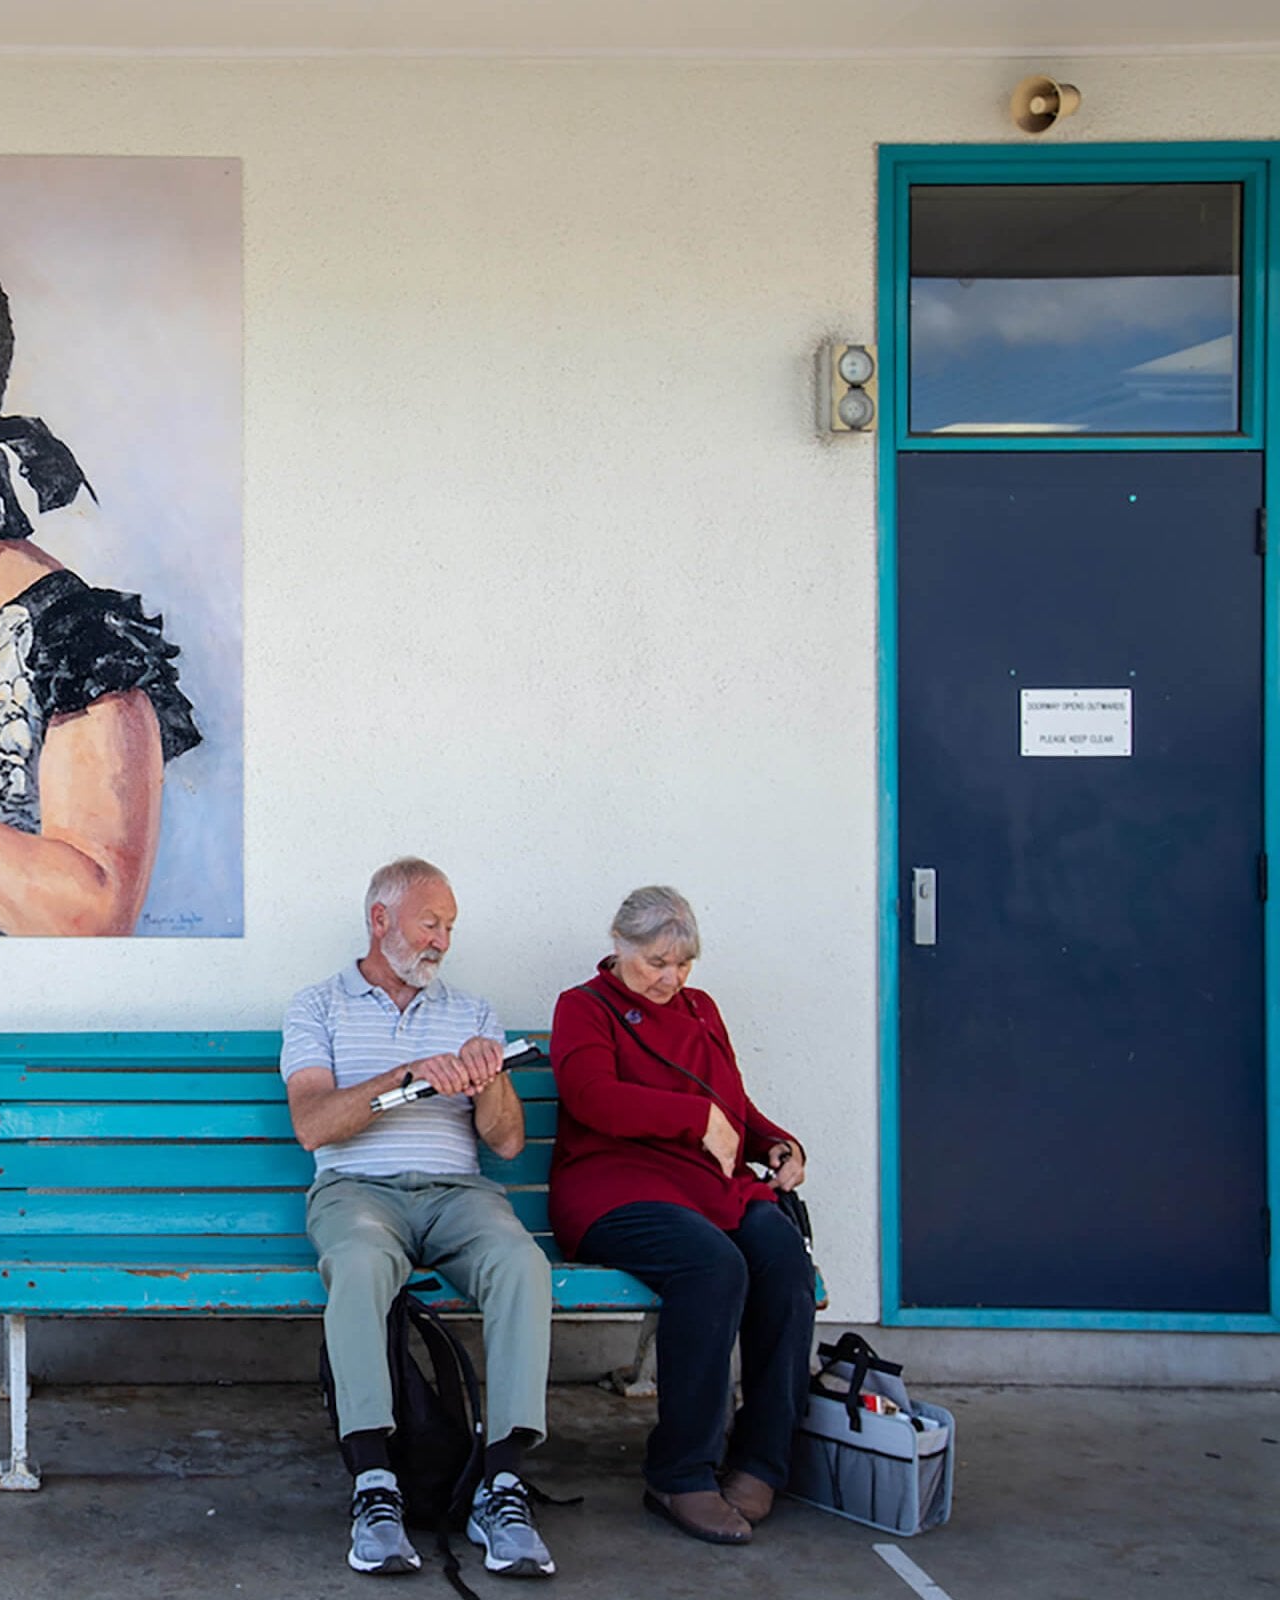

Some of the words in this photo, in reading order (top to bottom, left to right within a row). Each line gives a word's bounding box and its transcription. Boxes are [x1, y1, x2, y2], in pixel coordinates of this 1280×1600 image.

[1027, 702, 1060, 711] DOORWAY
[1062, 702, 1085, 711] OPENS
[1087, 702, 1125, 711] OUTWARDS
[1039, 734, 1066, 744] PLEASE
[1069, 734, 1088, 744] KEEP
[1089, 734, 1114, 744] CLEAR
